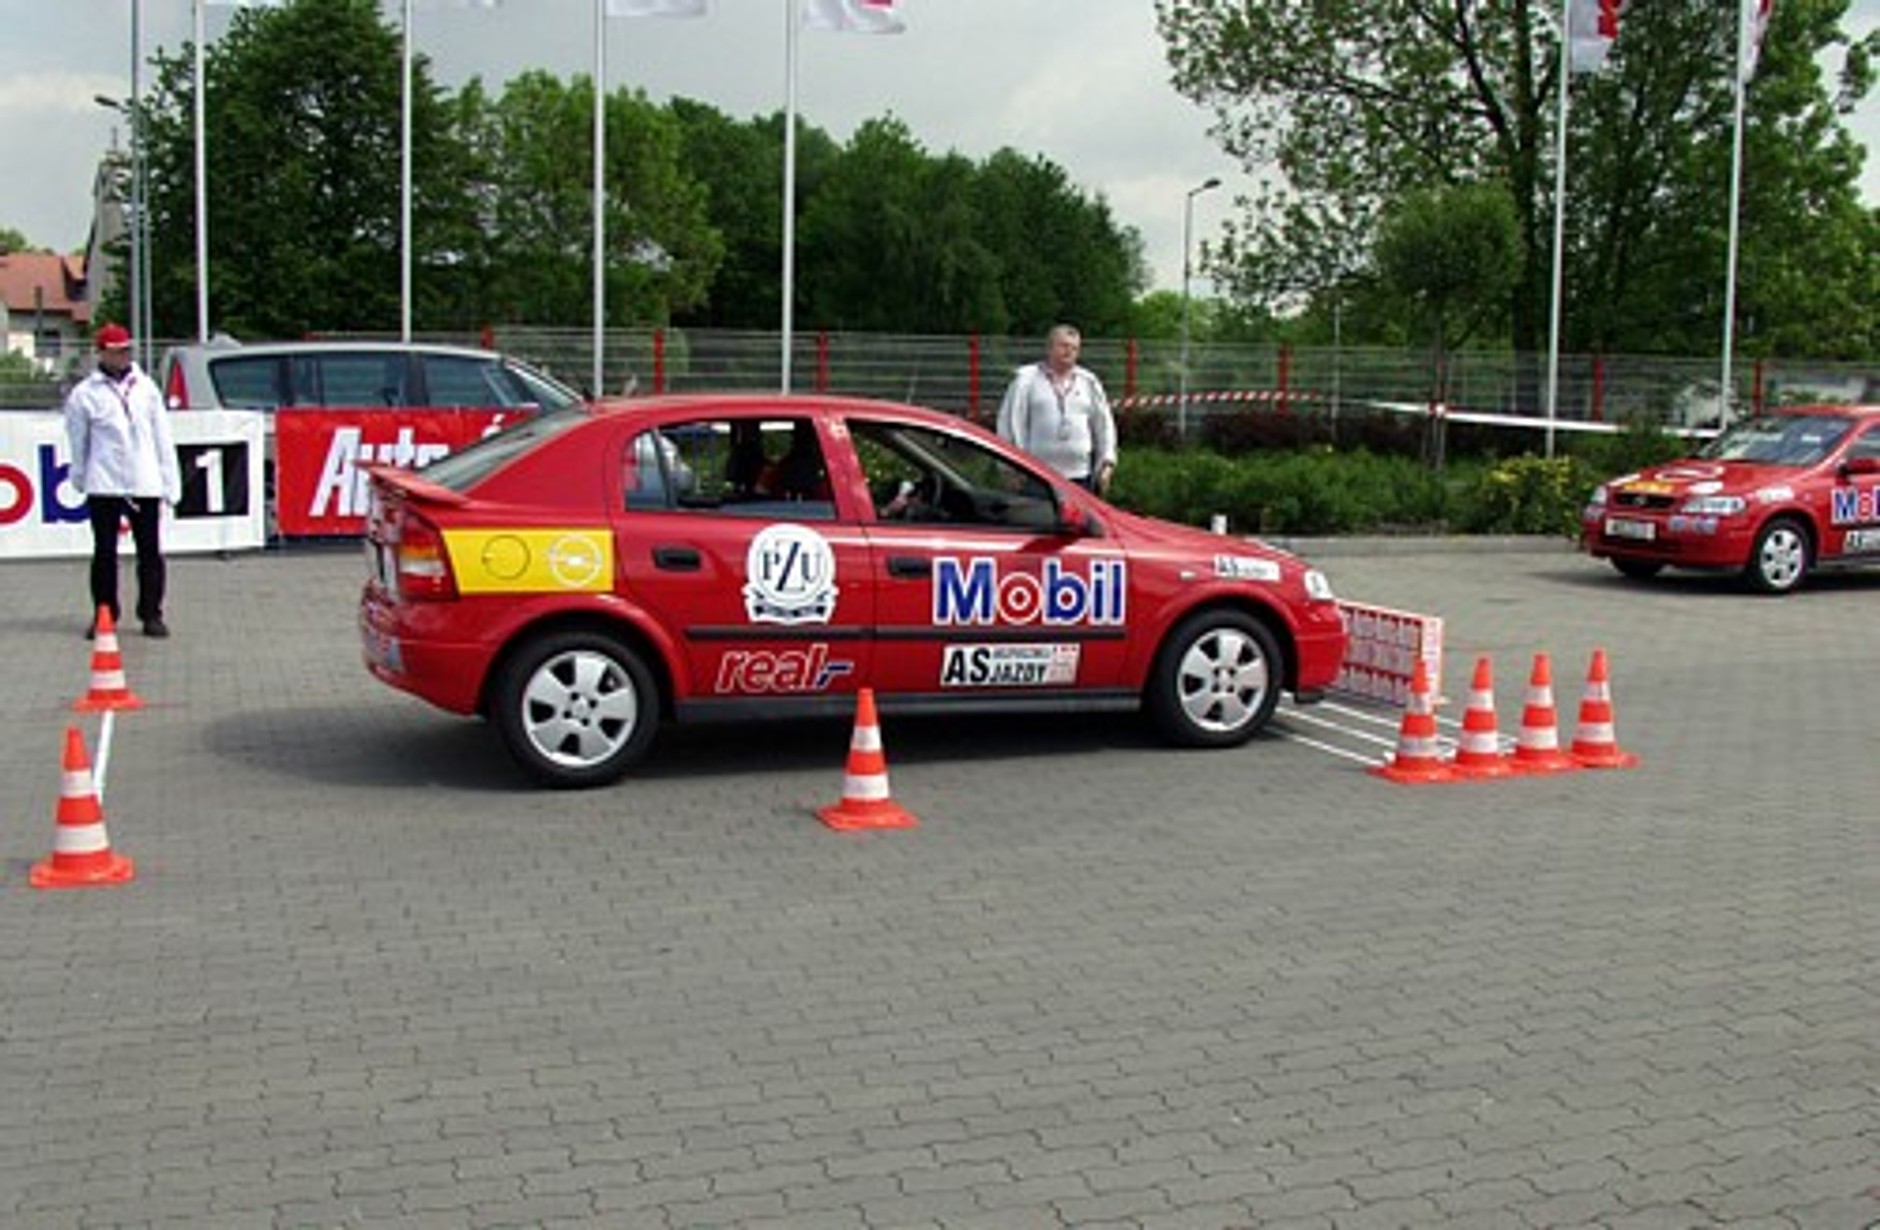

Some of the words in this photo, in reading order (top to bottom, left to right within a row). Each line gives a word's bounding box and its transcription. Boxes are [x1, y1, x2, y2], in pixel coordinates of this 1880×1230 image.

[195, 449, 224, 513] 1
[763, 540, 820, 592] PZU
[934, 557, 1126, 625] Mobil
[943, 648, 990, 682] AS
